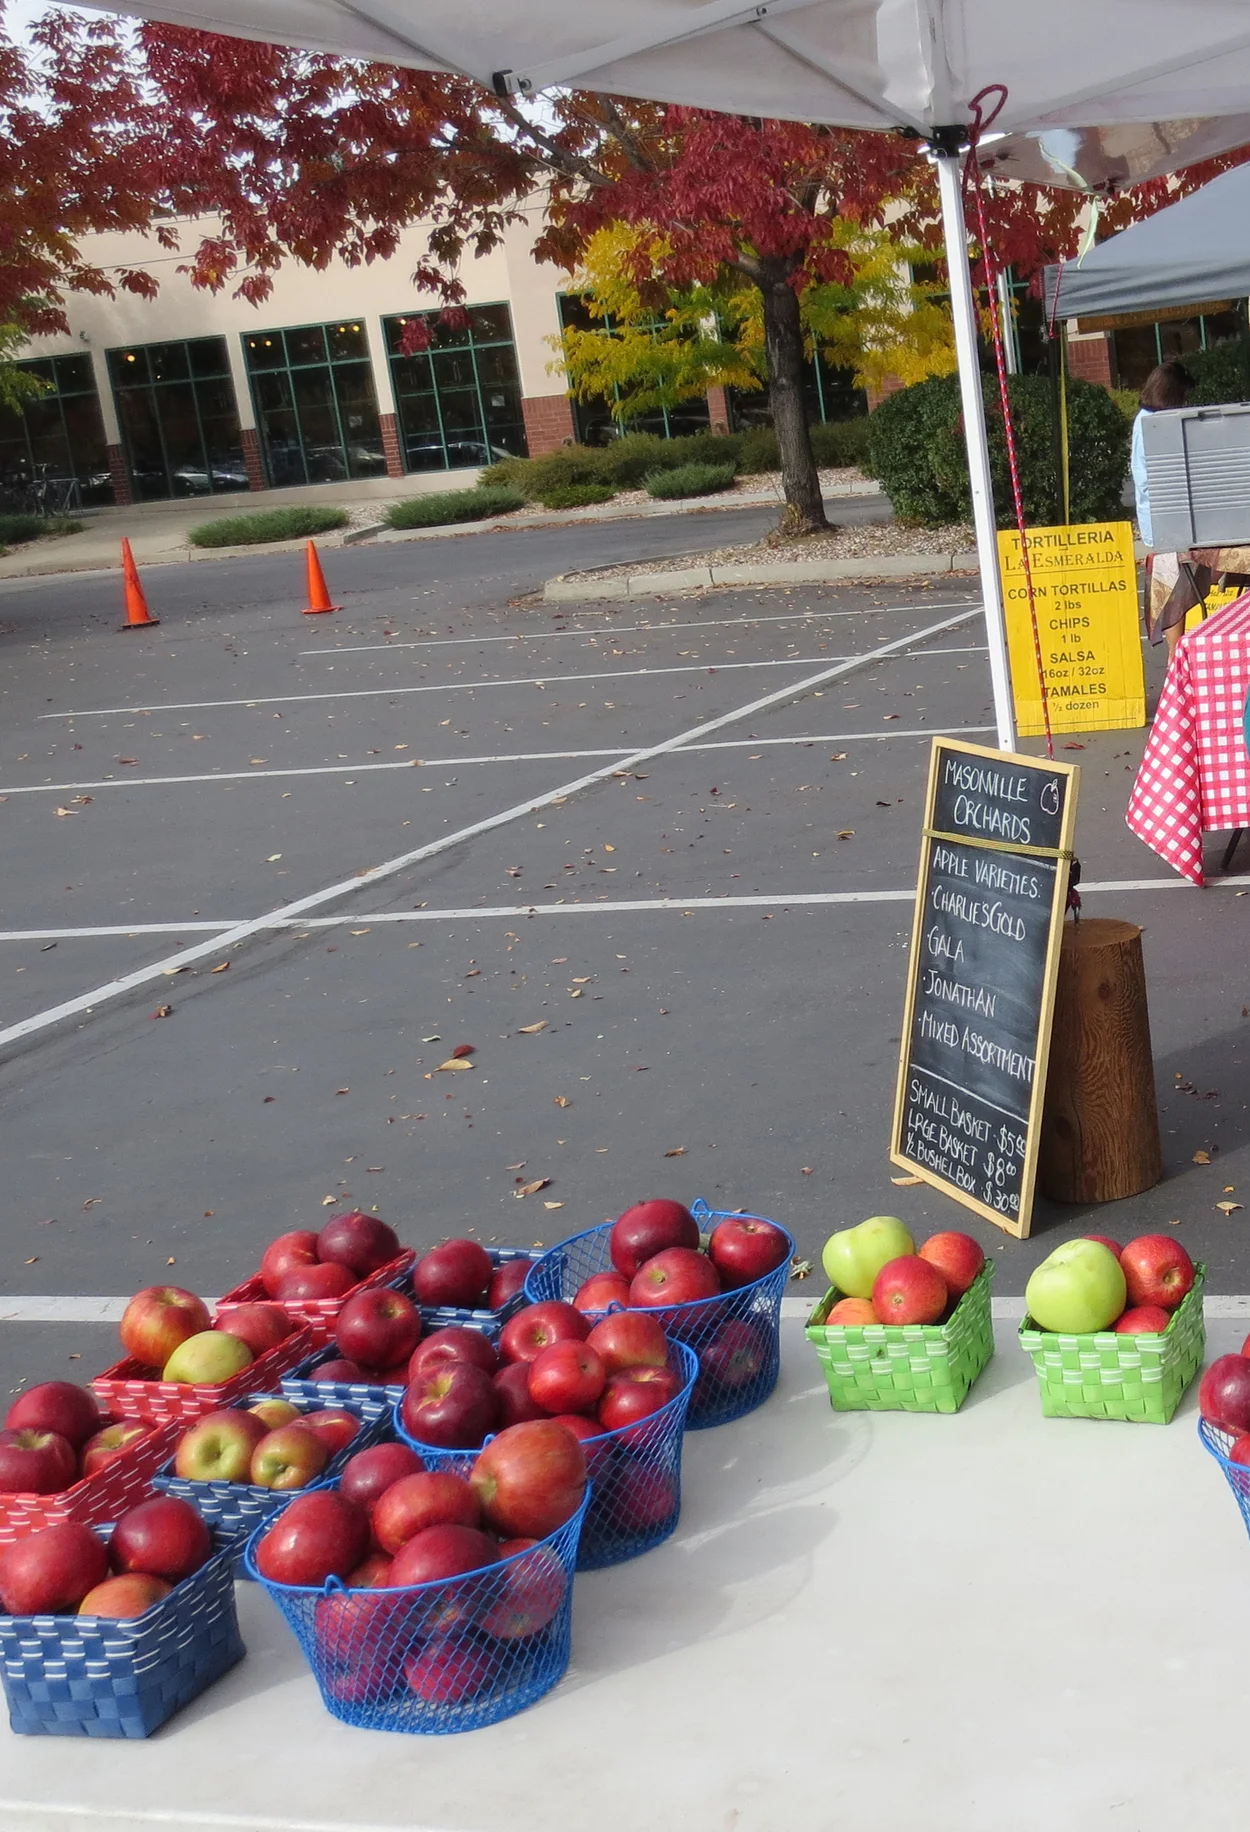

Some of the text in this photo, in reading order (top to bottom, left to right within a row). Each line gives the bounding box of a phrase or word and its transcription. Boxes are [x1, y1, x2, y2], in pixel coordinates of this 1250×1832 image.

[1011, 530, 1115, 550] TORTILLERIA
[1008, 579, 1127, 600] CORN TORTILLAS
[1055, 600, 1082, 611] 2 lbs
[1049, 616, 1091, 630] CHIPS
[1062, 634, 1081, 644] 1 lb
[1042, 668, 1069, 678] 16oz
[1078, 665, 1105, 676] 32oz
[1050, 650, 1096, 664] SALSA
[1044, 682, 1107, 698] TAMALES
[1065, 701, 1100, 711] dozen
[944, 759, 1029, 803] MASONVILLE
[954, 794, 1031, 844] ORCHARDS
[933, 845, 969, 878] APPLE
[989, 901, 1026, 941] GOLD
[928, 925, 964, 963] GALA
[925, 968, 997, 1018] JONATHAN
[921, 1009, 1037, 1083] MIXED ASSORTMENT
[909, 1079, 950, 1119] SMALL
[950, 1097, 992, 1143] BASKET
[908, 1107, 938, 1144] LRGE
[939, 1124, 979, 1167] BASKET
[917, 1140, 956, 1181] BUSHEL
[955, 1165, 976, 1194] BOX
